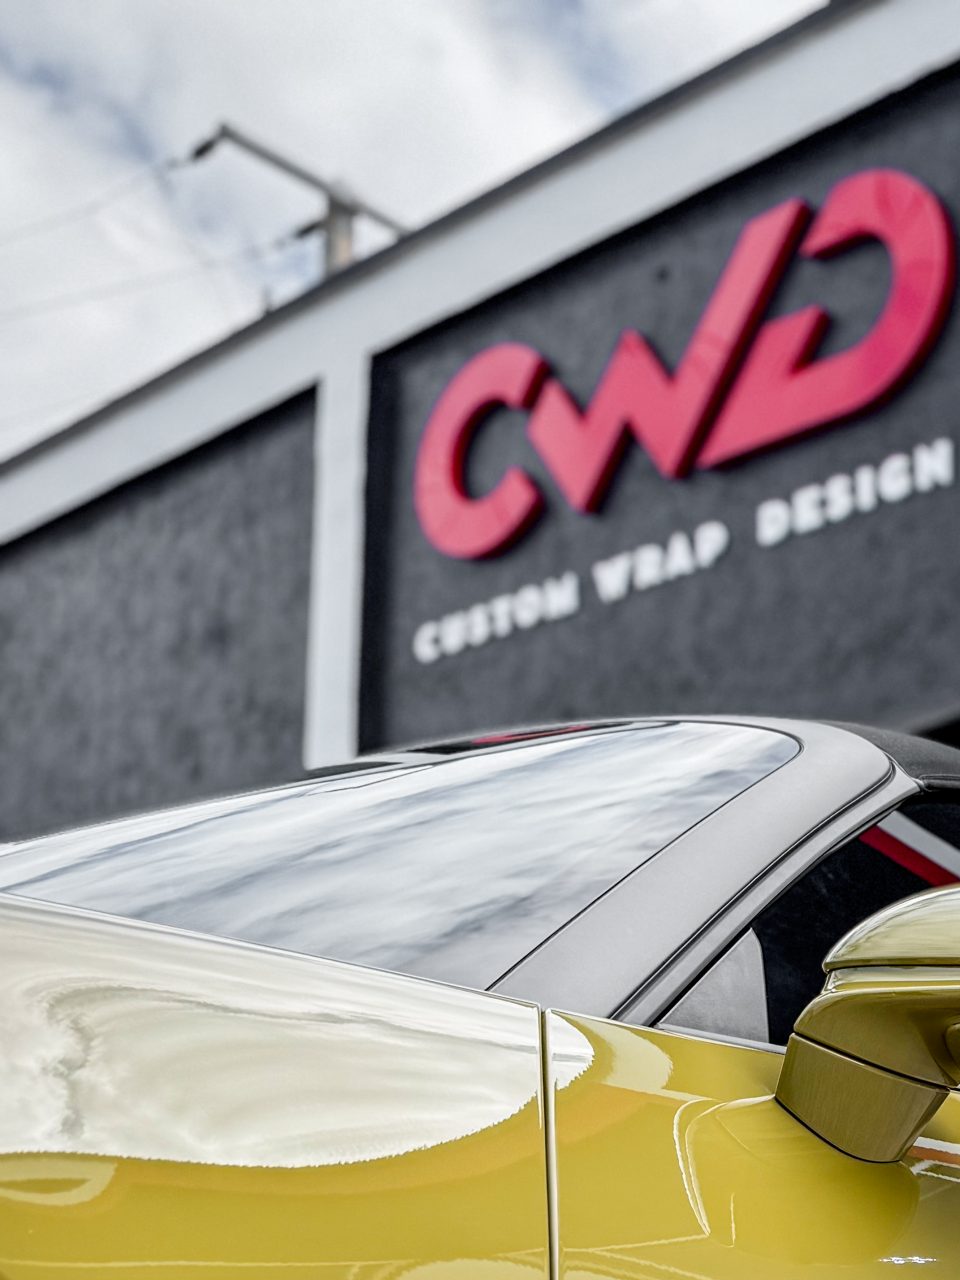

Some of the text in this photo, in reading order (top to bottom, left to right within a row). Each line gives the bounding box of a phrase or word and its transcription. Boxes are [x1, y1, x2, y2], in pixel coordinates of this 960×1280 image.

[414, 168, 957, 561] CWD
[413, 437, 955, 664] CUSTOM WRAP DESIGN
